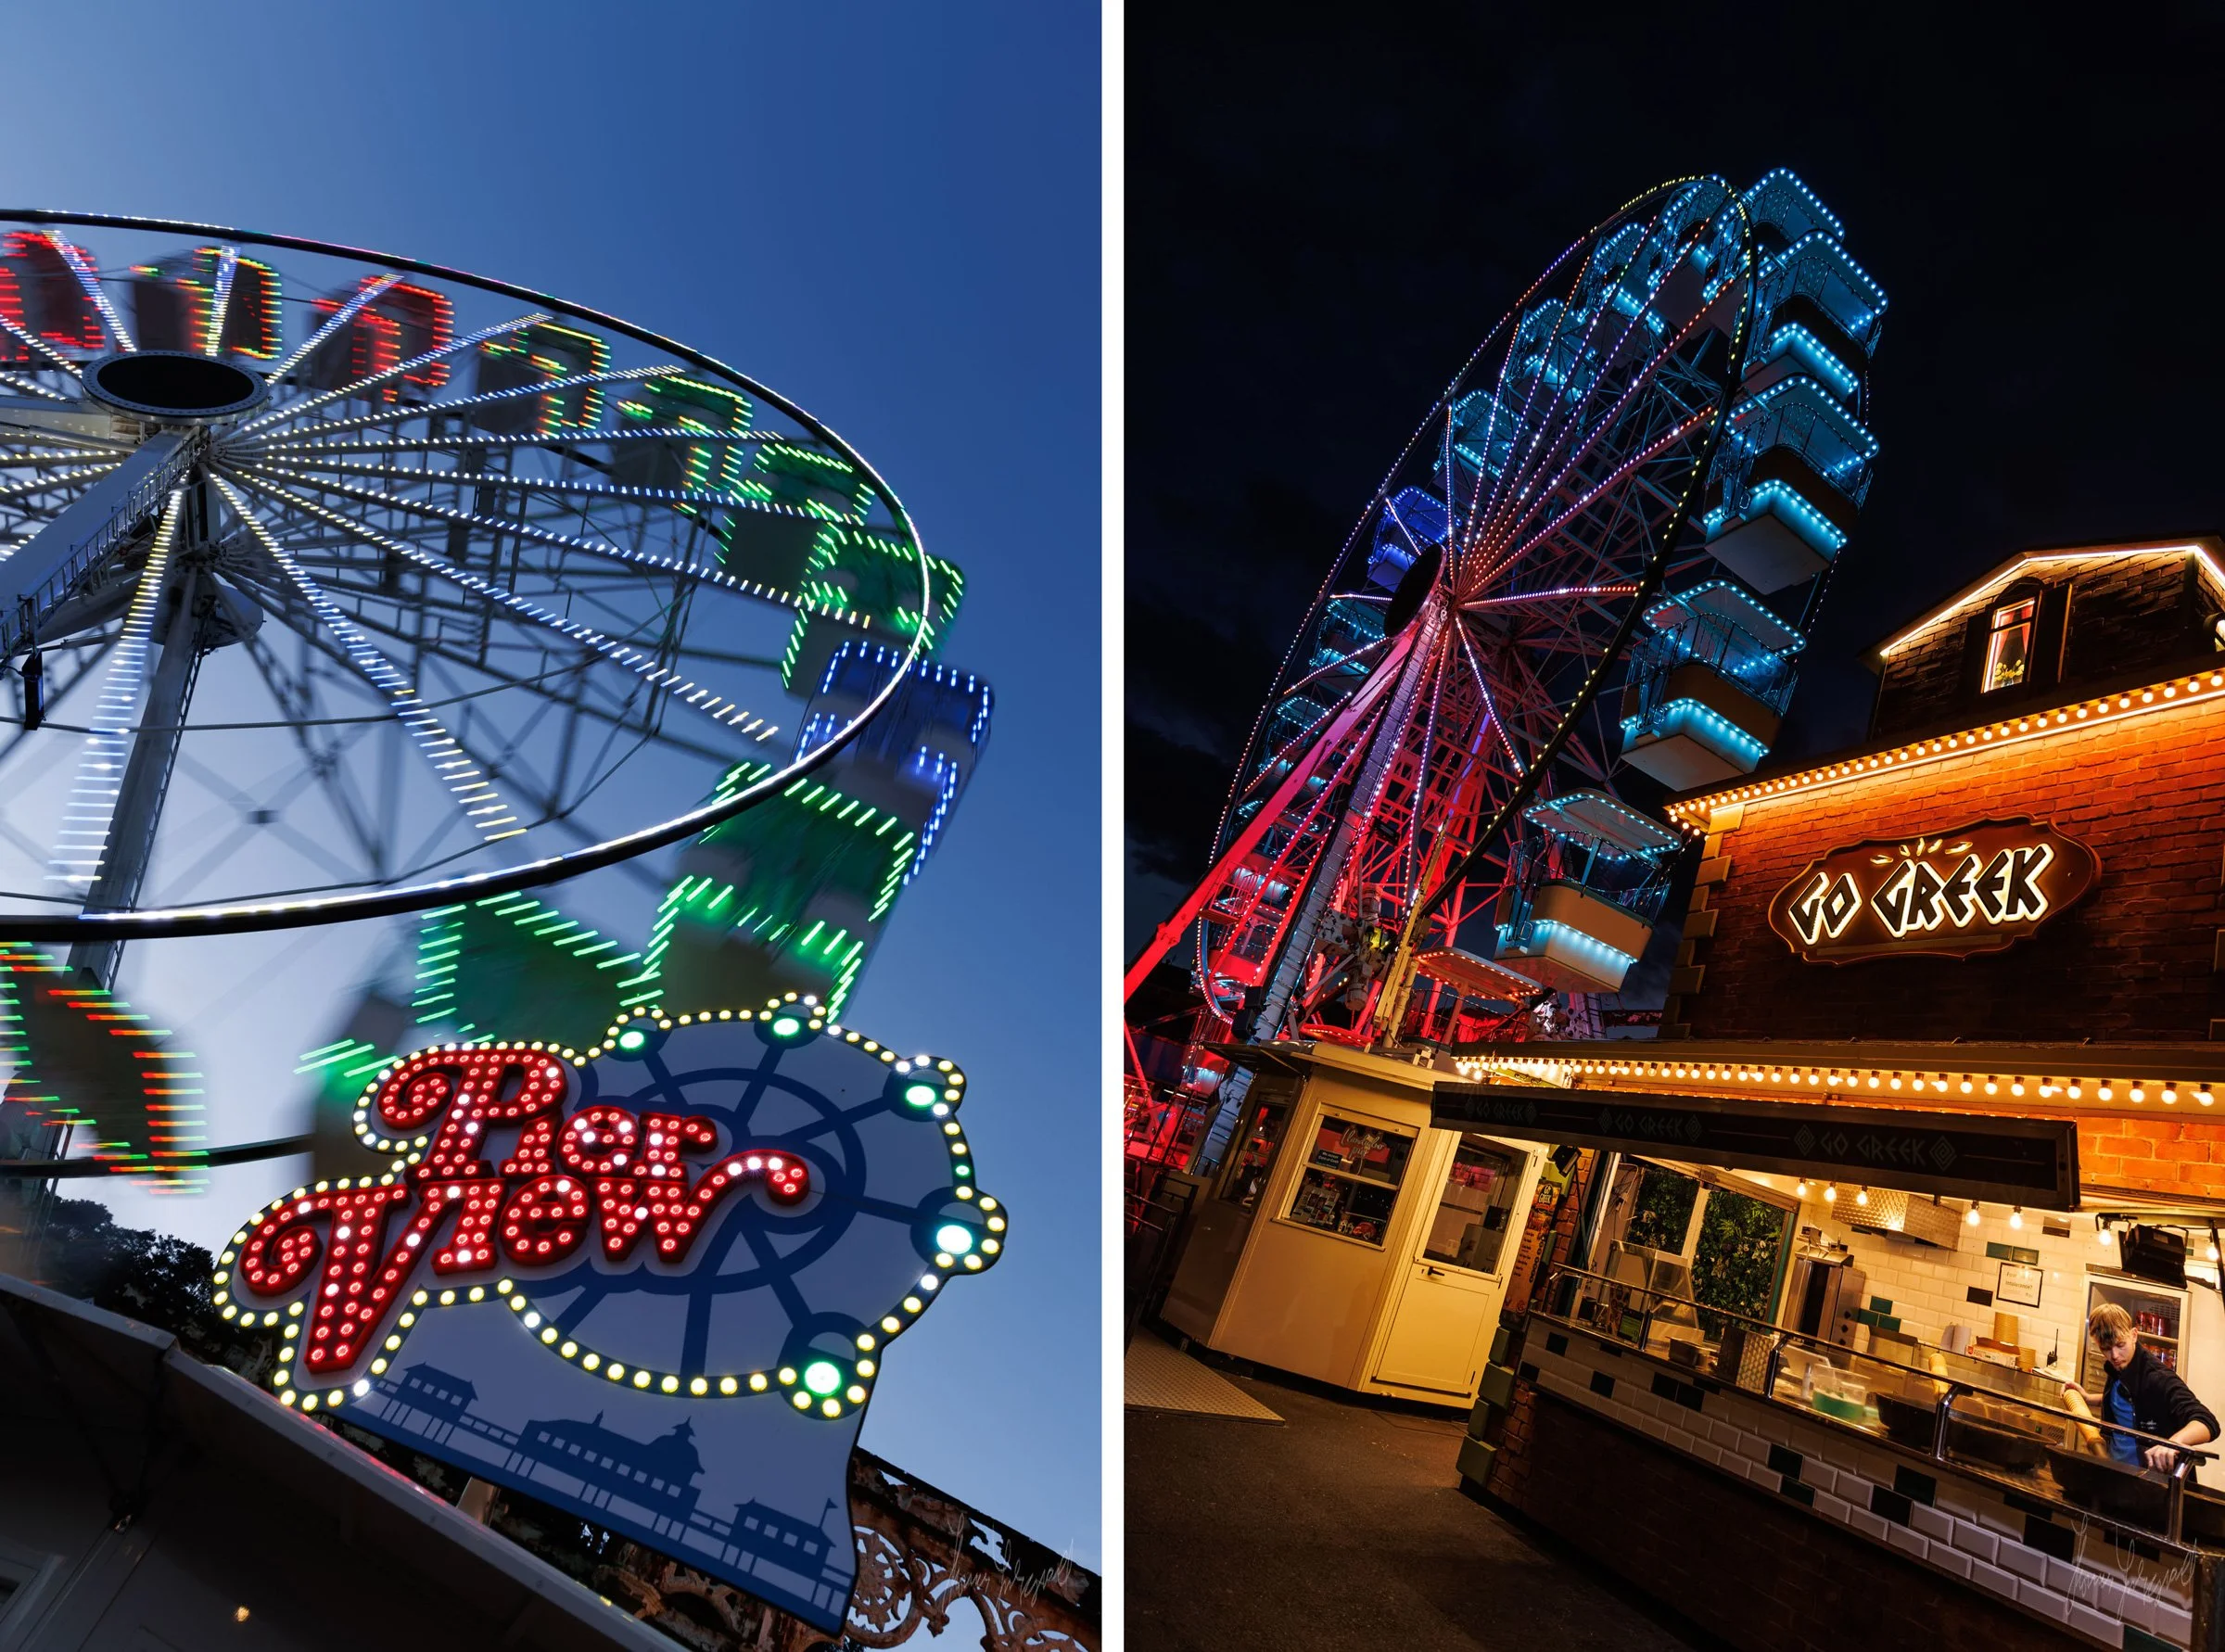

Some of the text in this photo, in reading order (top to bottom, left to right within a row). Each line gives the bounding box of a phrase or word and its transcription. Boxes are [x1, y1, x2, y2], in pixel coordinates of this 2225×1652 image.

[1787, 843, 2055, 946] GO GREEK
[376, 1048, 718, 1181] Pier
[1476, 1103, 1525, 1121] GO GREEK
[1614, 1112, 1685, 1140] GO GREEK
[1819, 1131, 1926, 1166] GO GREEK
[239, 1149, 811, 1374] View
